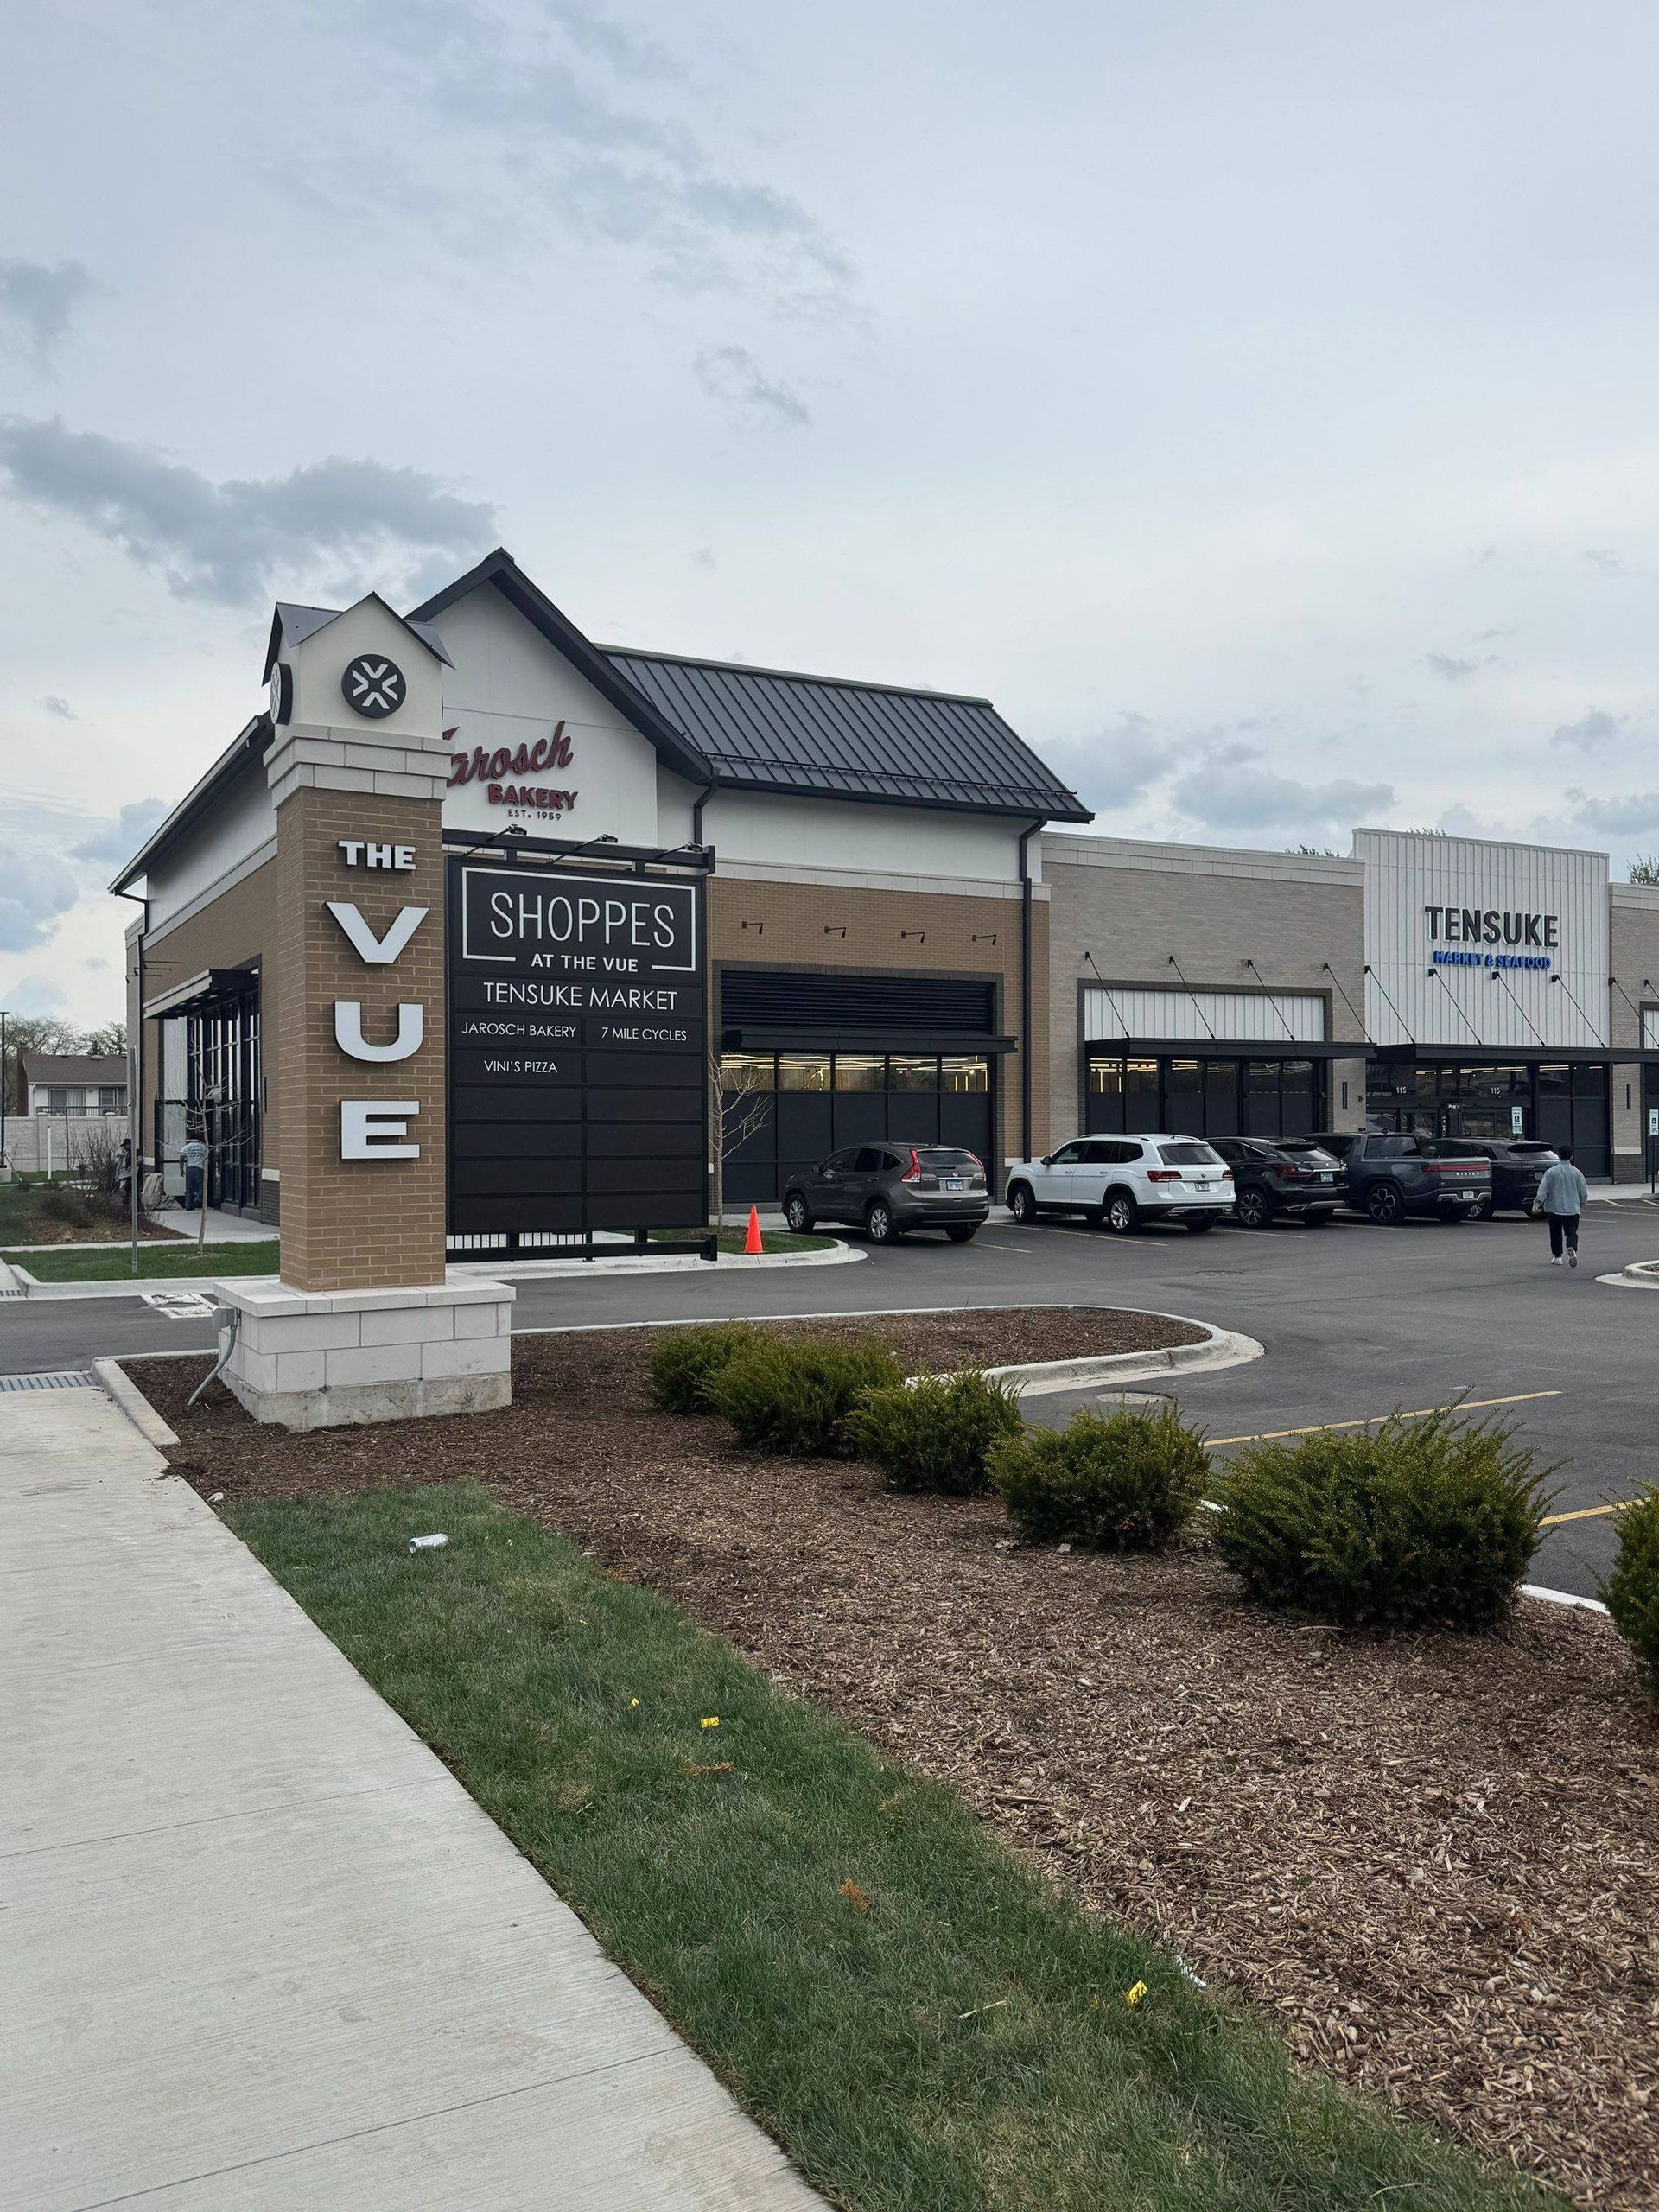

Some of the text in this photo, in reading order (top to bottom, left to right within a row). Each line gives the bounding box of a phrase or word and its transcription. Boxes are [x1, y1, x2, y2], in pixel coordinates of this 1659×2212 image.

[442, 720, 574, 788] arosch
[488, 783, 578, 810] BAKERY
[508, 809, 562, 821] EST. 1959
[338, 840, 416, 870] THE
[490, 892, 675, 948] SHOPPES
[1425, 906, 1558, 948] TENSUKE
[531, 954, 639, 972] AT THE VUE
[1433, 950, 1552, 969] MARKET & SEAFOOD
[484, 982, 678, 1010] TENSUKE MARKET
[461, 1022, 577, 1038] JAROSCH BAKERY
[601, 1027, 687, 1041] 7 MILE CYCLES
[484, 1060, 558, 1073] VINI'S PIZZA
